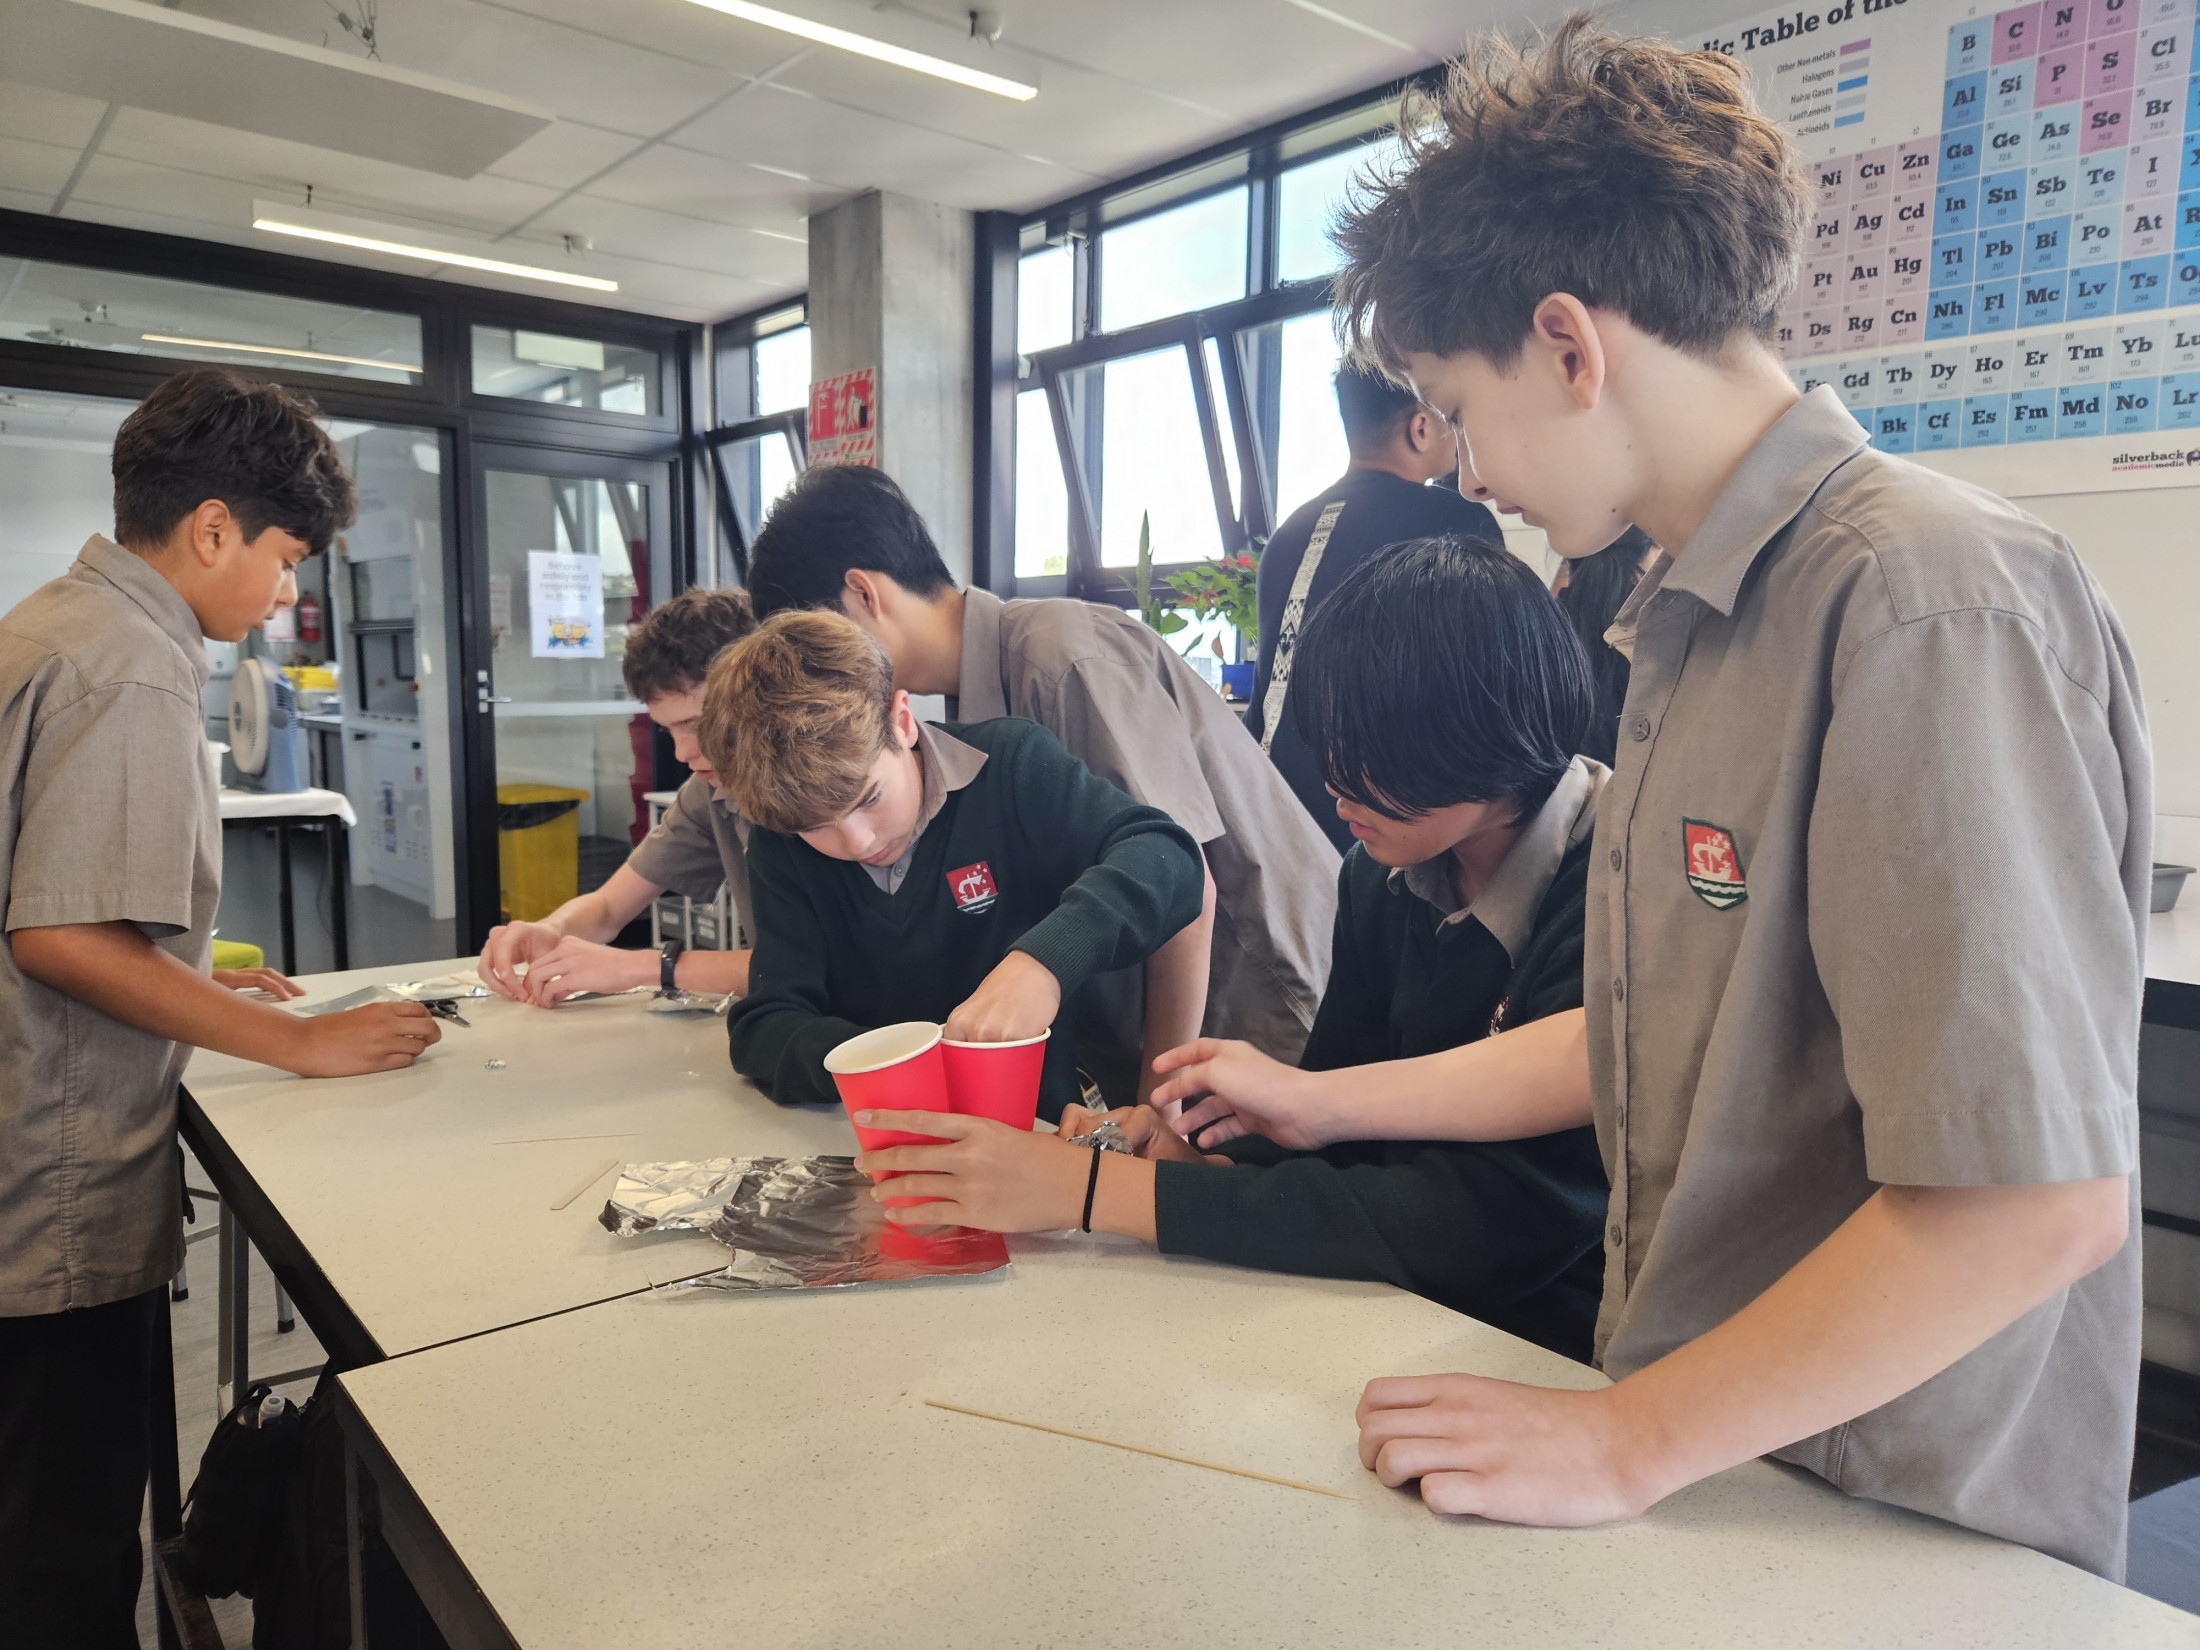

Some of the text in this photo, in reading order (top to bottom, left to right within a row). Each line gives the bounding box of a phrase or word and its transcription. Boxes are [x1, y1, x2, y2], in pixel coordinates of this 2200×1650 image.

[2055, 8, 2074, 27] N
[1741, 12, 1820, 52] Table
[2008, 22, 2025, 39] C
[1961, 35, 1976, 52] B
[2151, 36, 2177, 57] Cl
[1777, 50, 1836, 75] Other Non-metals
[2102, 52, 2120, 71] S
[1802, 69, 1835, 84] Halogens
[2051, 65, 2067, 82] P
[1812, 86, 1834, 99] Gases
[1999, 75, 2023, 96] Si
[1952, 87, 1977, 107] Al
[2145, 99, 2173, 118] Br
[2091, 111, 2122, 130] Se
[2040, 122, 2071, 141] As
[1992, 132, 2022, 150] Ge
[1946, 143, 1975, 160] Ga
[1903, 154, 1930, 170] Zn
[2148, 156, 2159, 174] I
[1821, 170, 1842, 188] Ni
[1860, 164, 1886, 179] Cu
[2087, 168, 2116, 187] Te
[2035, 175, 2068, 197] Sb
[1945, 197, 1967, 213] In
[1987, 187, 2019, 205] Sn
[1899, 203, 1925, 221] Cd
[1816, 220, 1840, 239] Pd
[1855, 214, 1883, 231] Ag
[2133, 214, 2163, 234] At
[2035, 231, 2059, 250] Bi
[2081, 225, 2111, 242] Po
[1942, 247, 1964, 266] Tl
[1985, 240, 2014, 259] Pb
[1850, 266, 1879, 281] Au
[1894, 257, 1923, 275] Hg
[1813, 273, 1833, 288] Pt
[2129, 273, 2159, 290] Ts
[2025, 287, 2060, 306] Mc
[2078, 282, 2107, 298] Lv
[1891, 310, 1917, 325] Cn
[1933, 300, 1964, 319] Nh
[1809, 323, 1832, 338] Ds
[1848, 316, 1875, 332] Rg
[2068, 345, 2105, 361] Tm
[2122, 336, 2154, 355] Yb
[1975, 357, 2004, 373] Ho
[2025, 351, 2049, 367] Er
[1843, 372, 1871, 389] Gd
[1886, 367, 1913, 384] Tb
[1930, 363, 1958, 381] Dy
[2062, 397, 2100, 416] Md
[2116, 394, 2149, 412] No
[2173, 389, 2200, 406] Lr
[1928, 412, 1952, 430] Cf
[1972, 410, 1997, 426] Es
[2015, 406, 2049, 422] Fm
[1881, 417, 1908, 435] Bk
[2112, 449, 2185, 465] silverback
[2112, 460, 2185, 472] academicmedia
